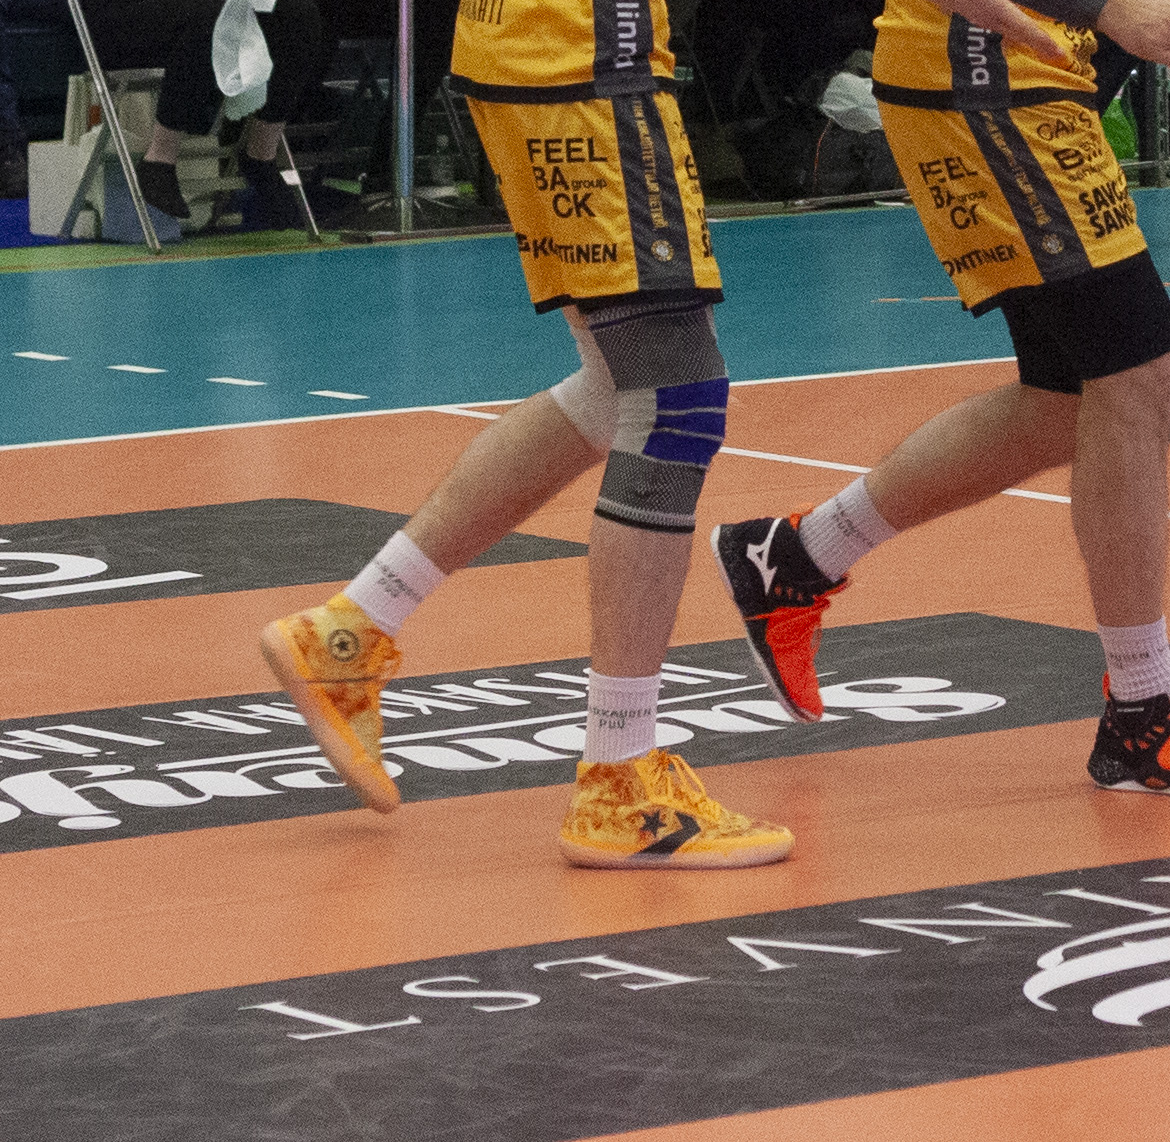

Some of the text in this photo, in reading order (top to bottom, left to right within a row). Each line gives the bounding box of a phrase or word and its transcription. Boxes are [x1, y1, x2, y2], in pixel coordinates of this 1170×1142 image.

[966, 25, 992, 87] inna
[526, 136, 608, 164] FEEL
[532, 165, 608, 192] BA group
[552, 192, 598, 219] CK
[0, 676, 1007, 830] Suonenj
